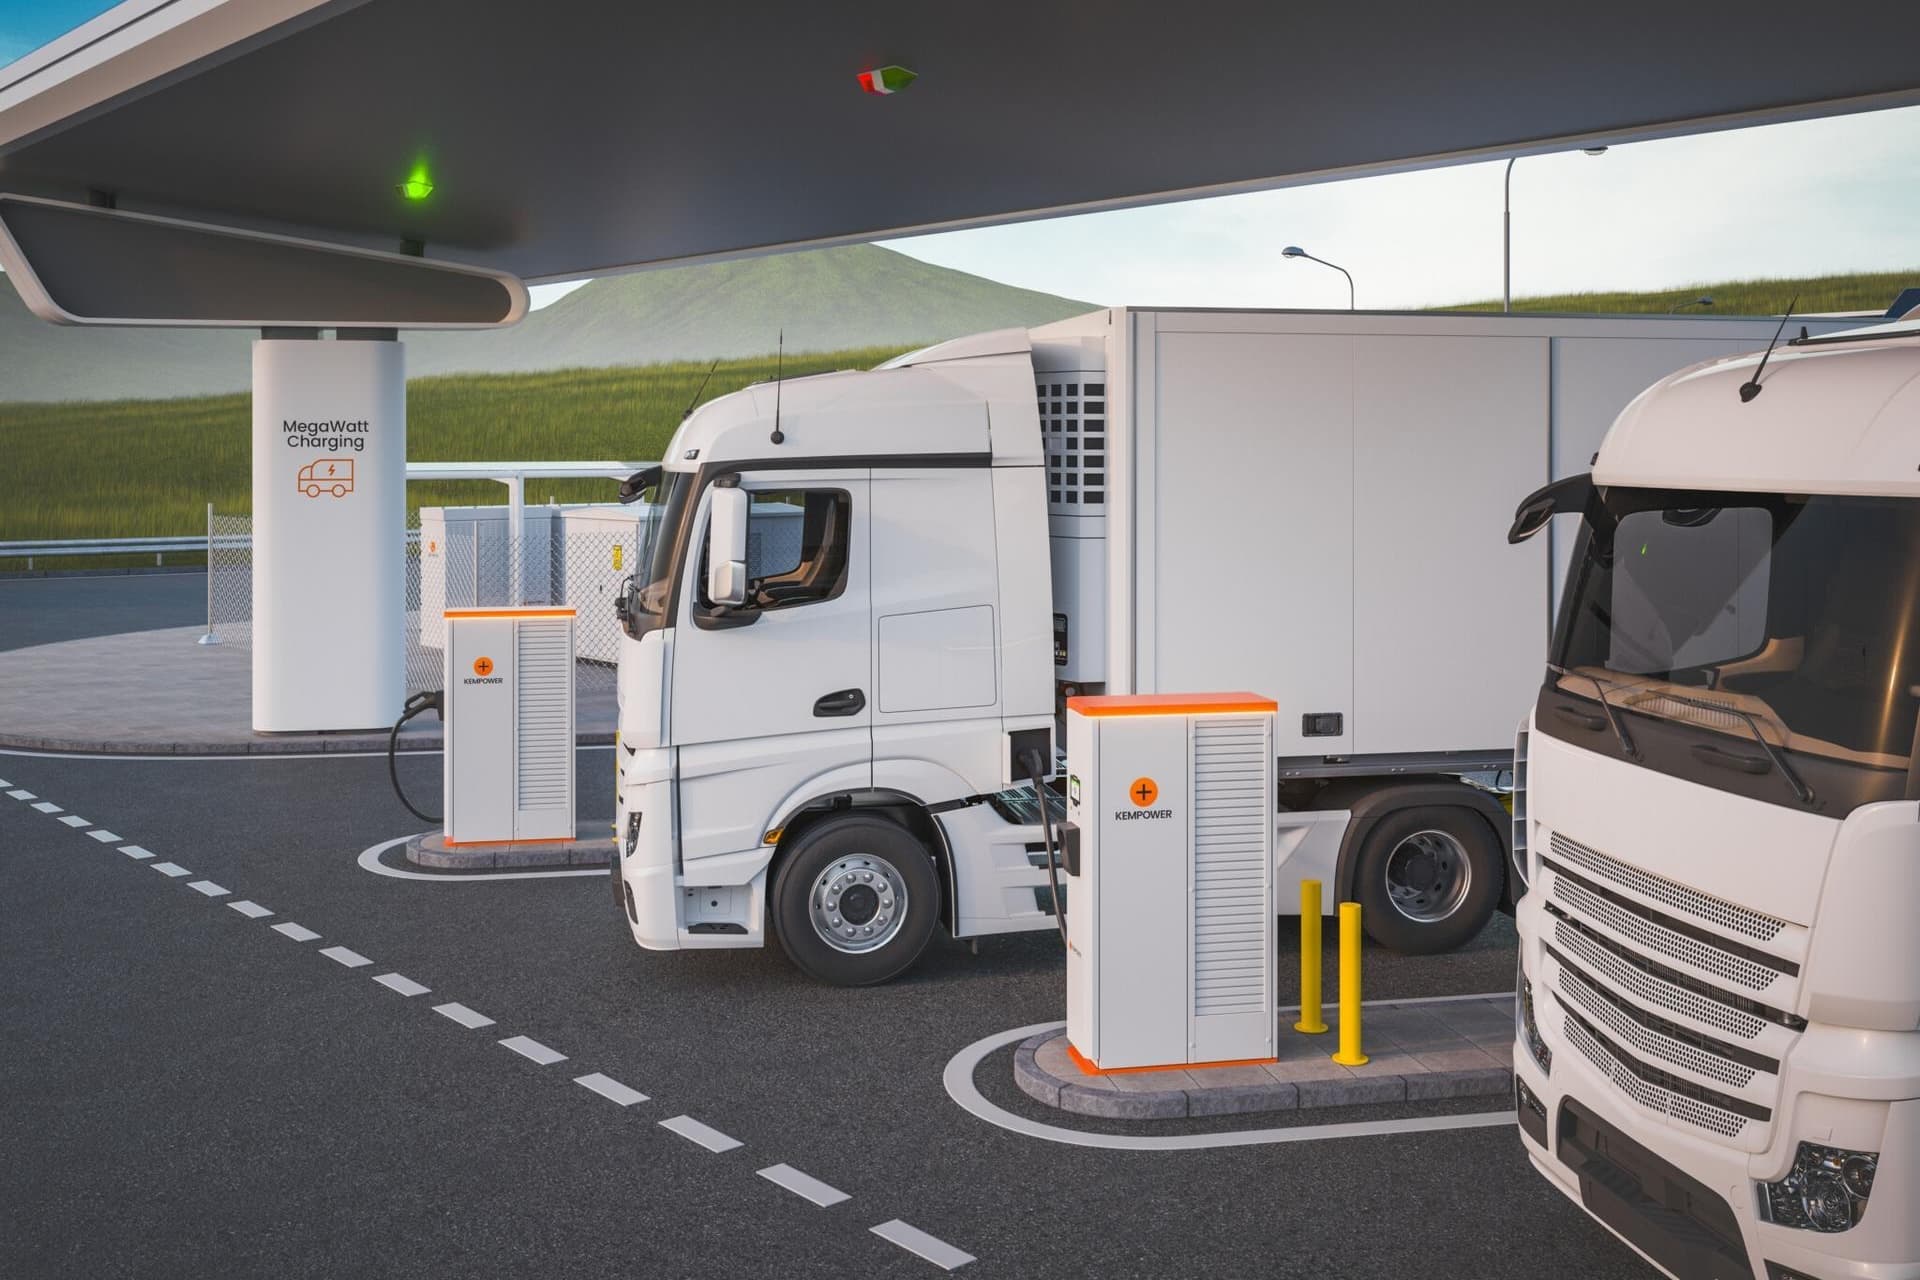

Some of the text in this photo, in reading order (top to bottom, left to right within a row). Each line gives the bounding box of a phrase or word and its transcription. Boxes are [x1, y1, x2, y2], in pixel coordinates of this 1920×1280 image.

[283, 420, 369, 436] MegaWatt
[287, 435, 364, 451] Charging
[463, 677, 503, 685] KEMPOWER
[1115, 810, 1172, 821] KEMPOWER
